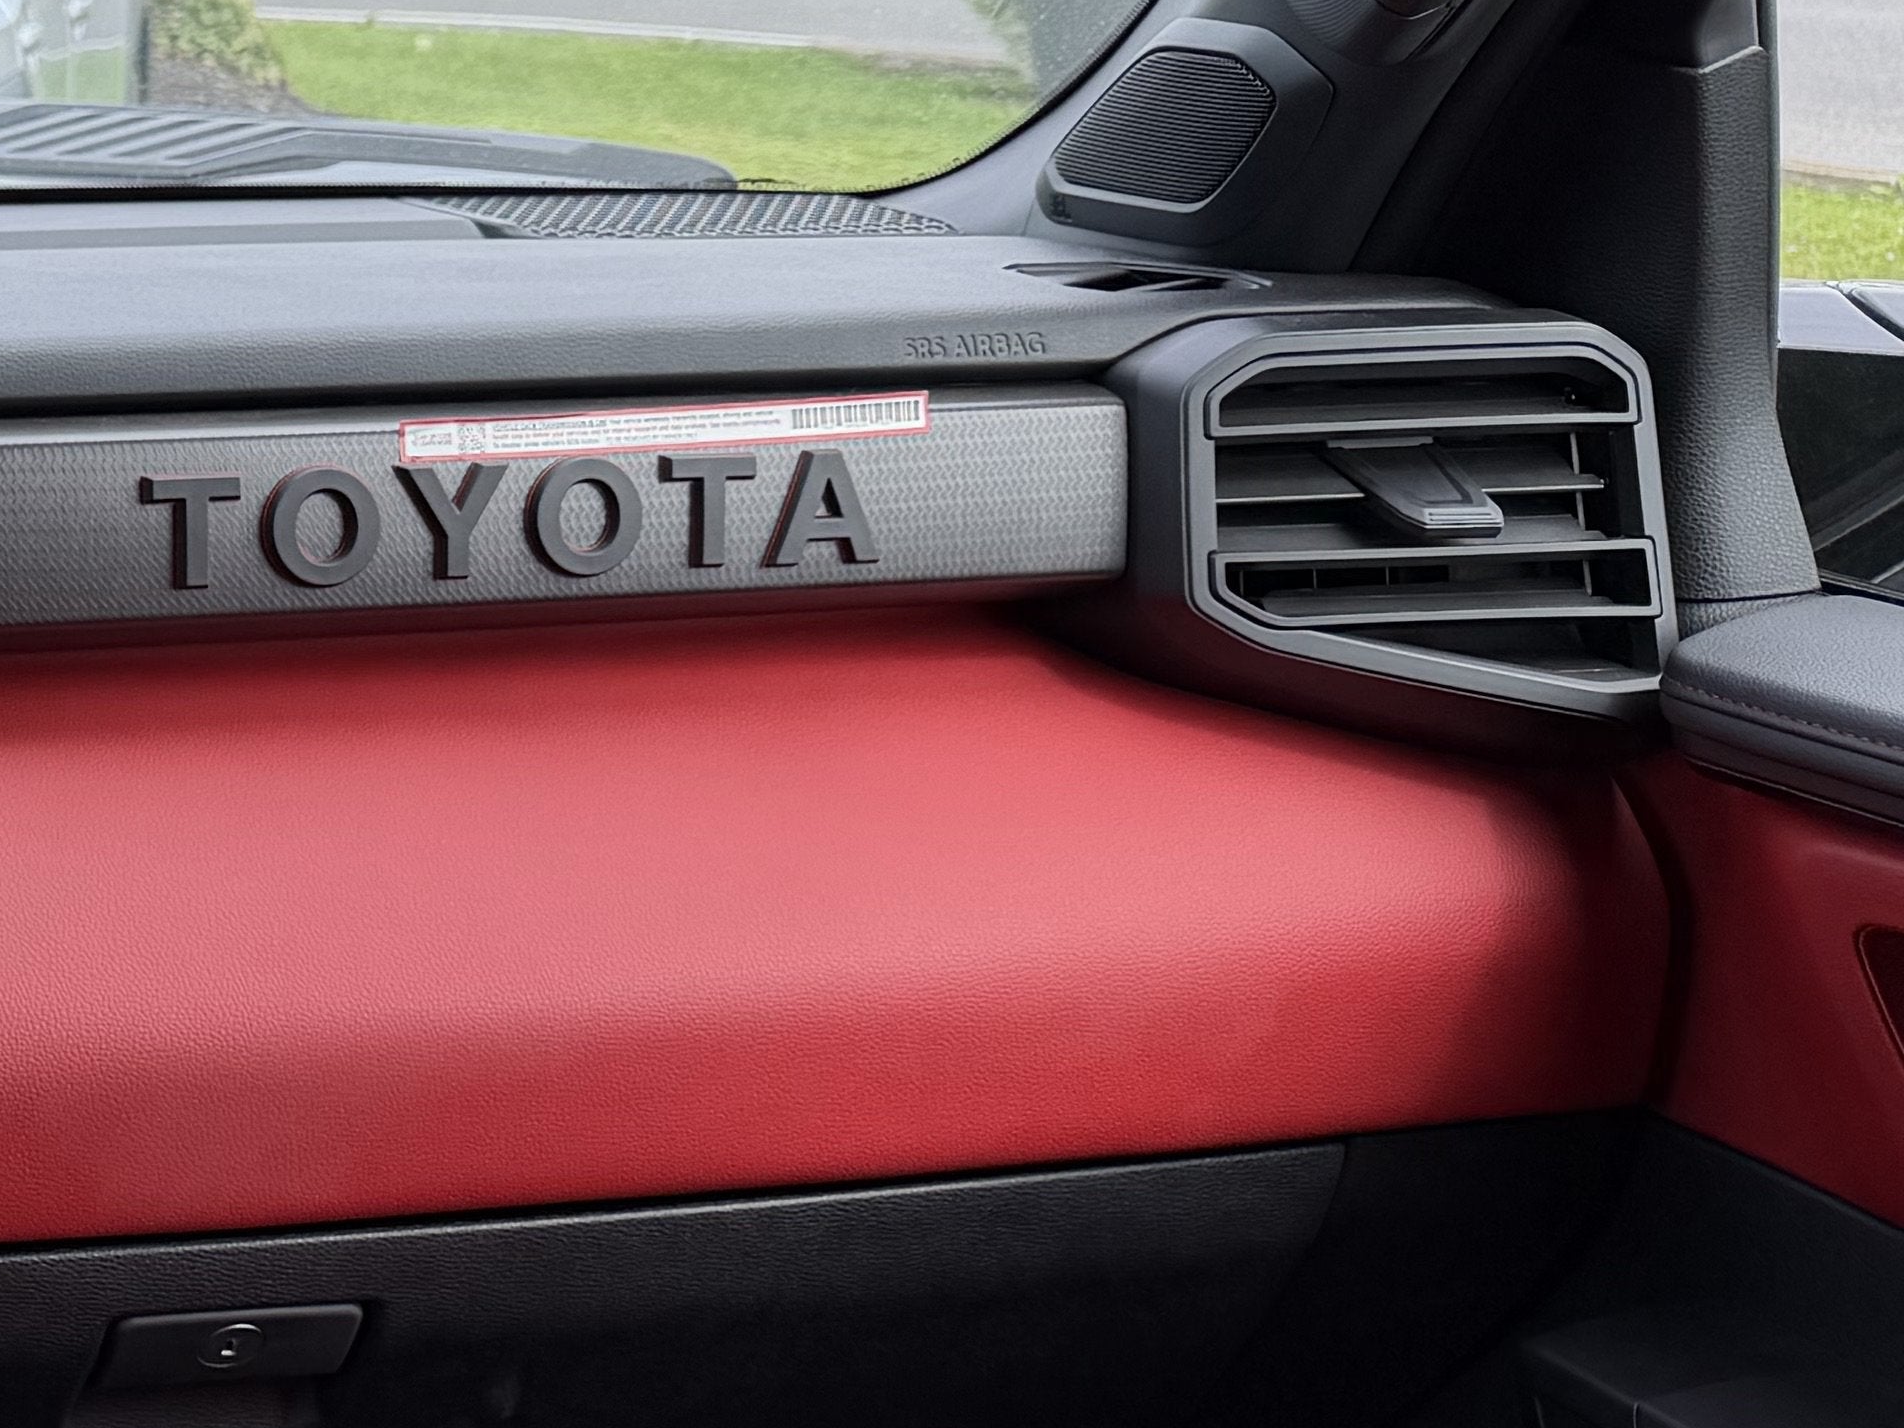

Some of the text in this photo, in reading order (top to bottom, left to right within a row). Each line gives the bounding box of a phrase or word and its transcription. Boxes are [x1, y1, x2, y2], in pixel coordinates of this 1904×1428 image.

[904, 331, 1046, 359] SRS AIRBAG
[140, 448, 882, 590] TOYOTA
